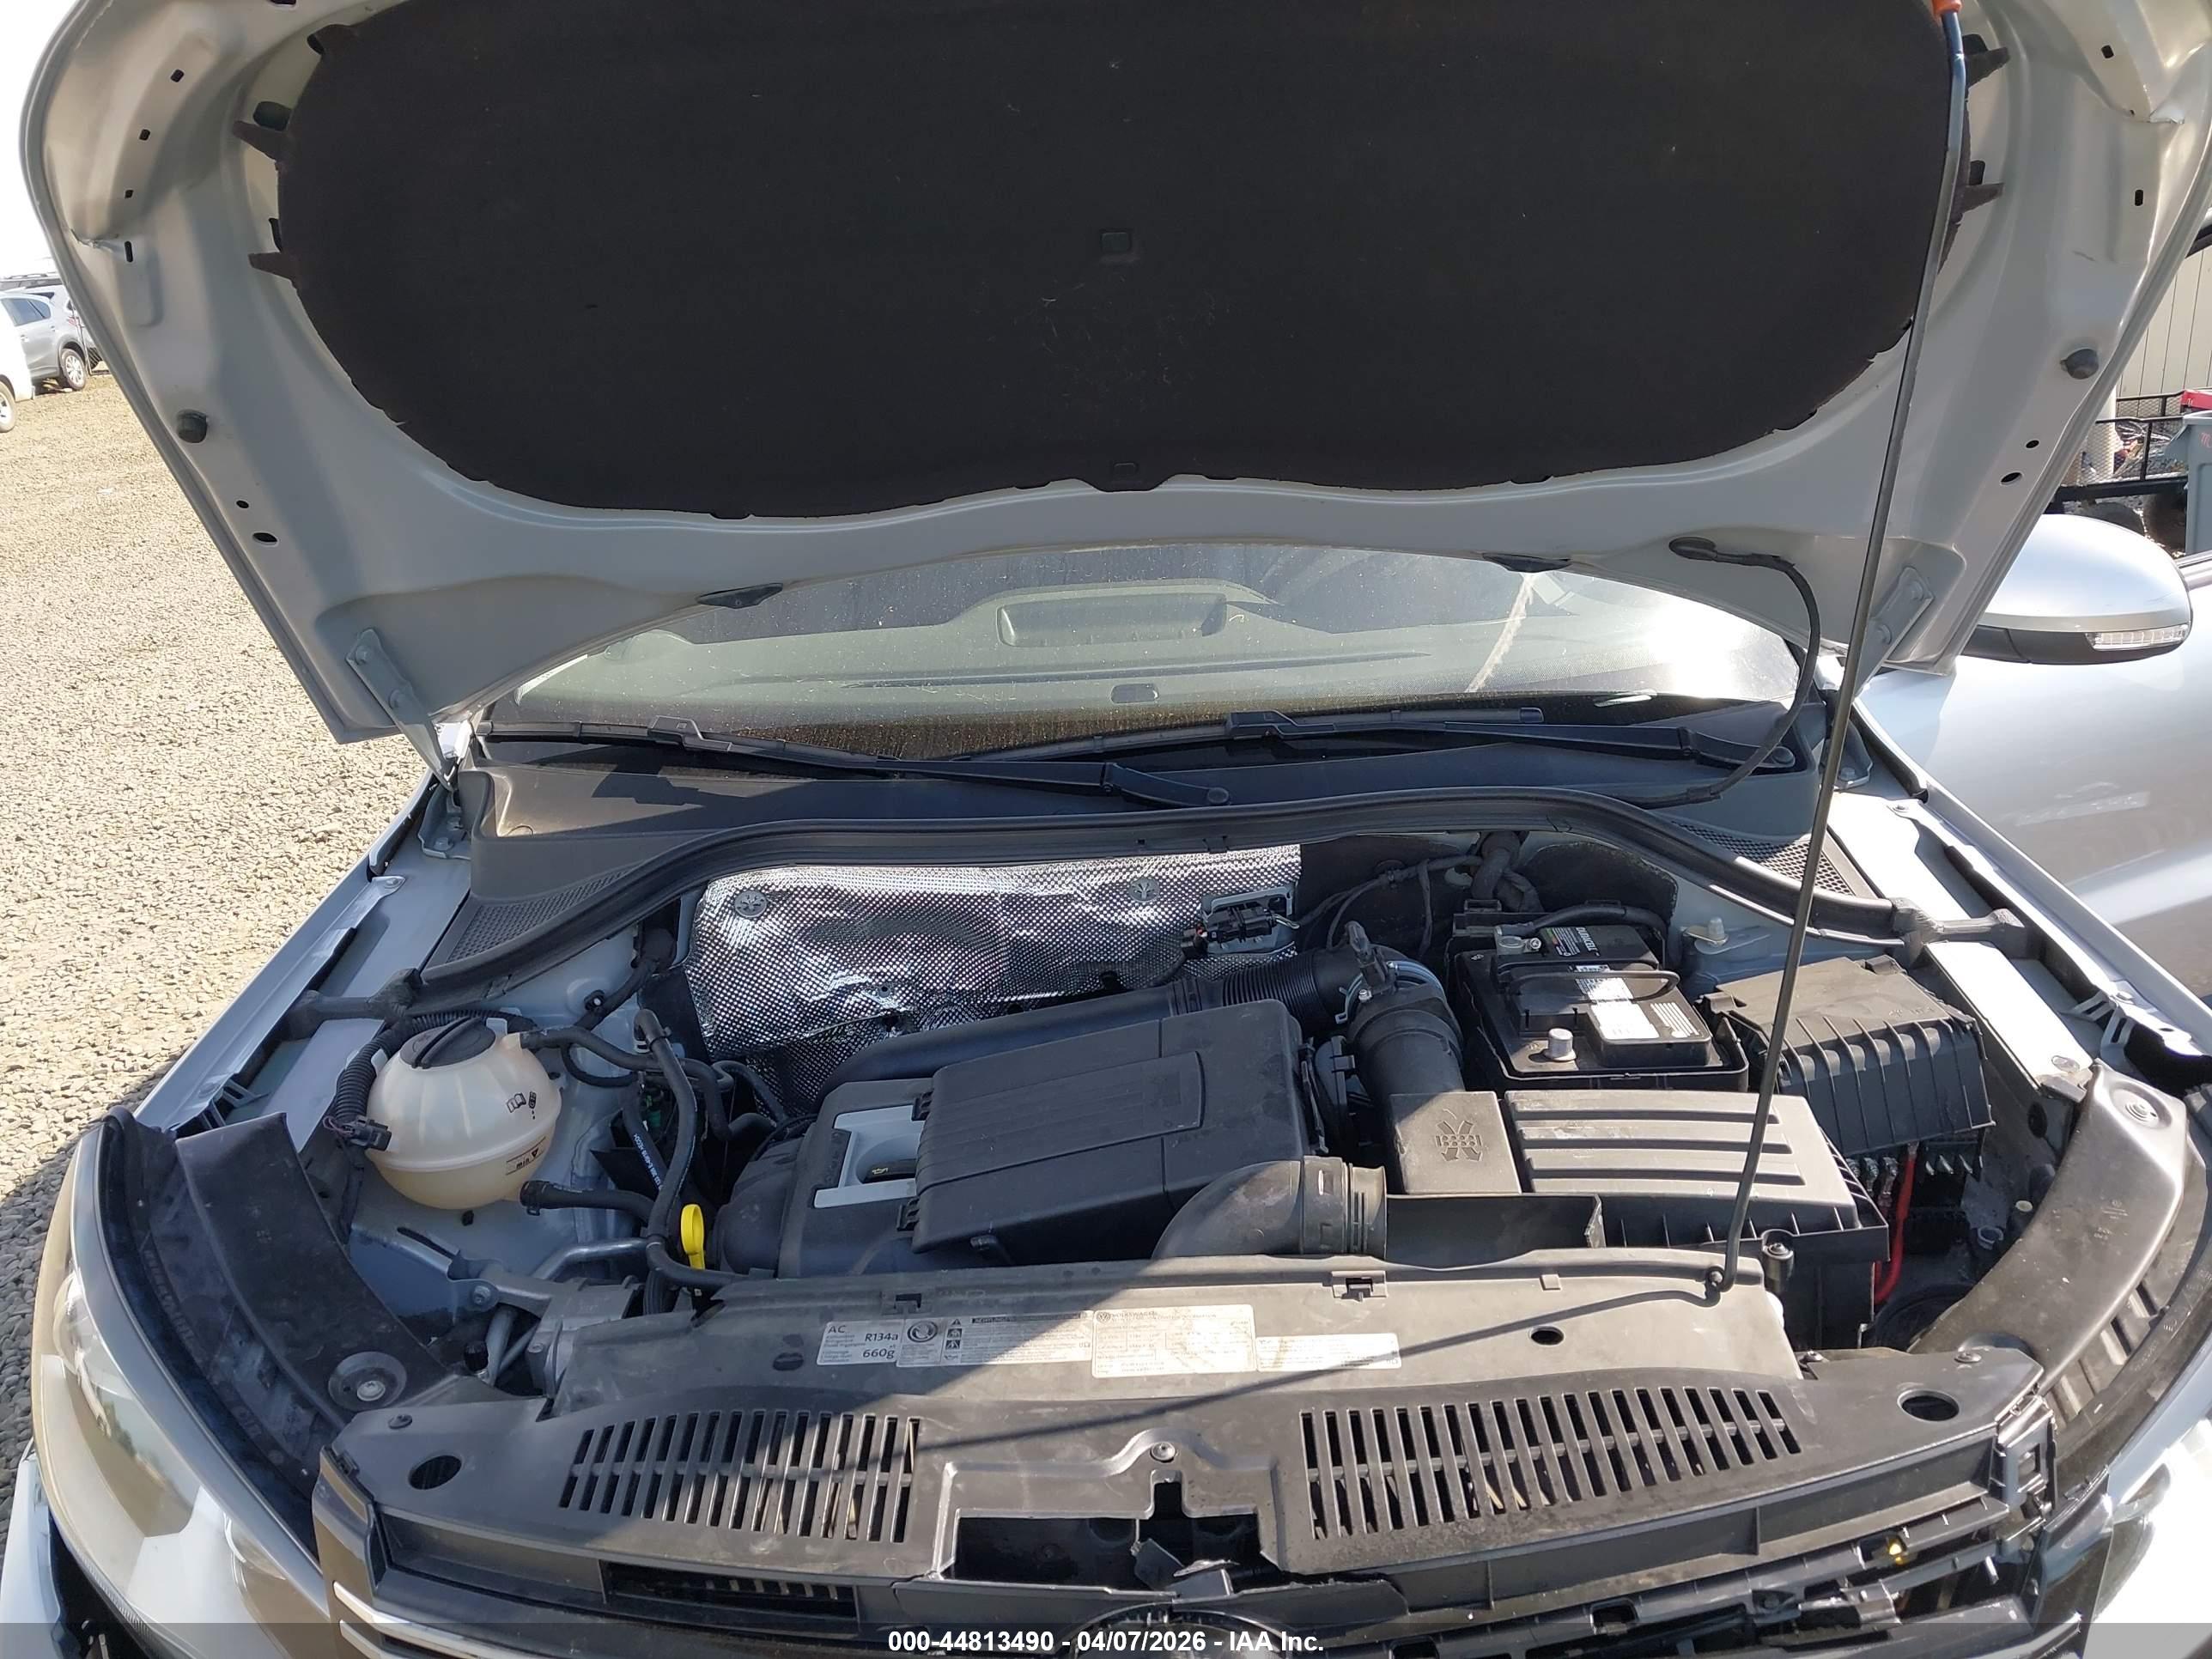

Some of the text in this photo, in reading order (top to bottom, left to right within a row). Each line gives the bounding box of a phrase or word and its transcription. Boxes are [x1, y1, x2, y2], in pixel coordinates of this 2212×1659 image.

[828, 1324, 846, 1334] AC
[865, 1333, 899, 1341] R134a
[863, 1348, 895, 1359] 660g
